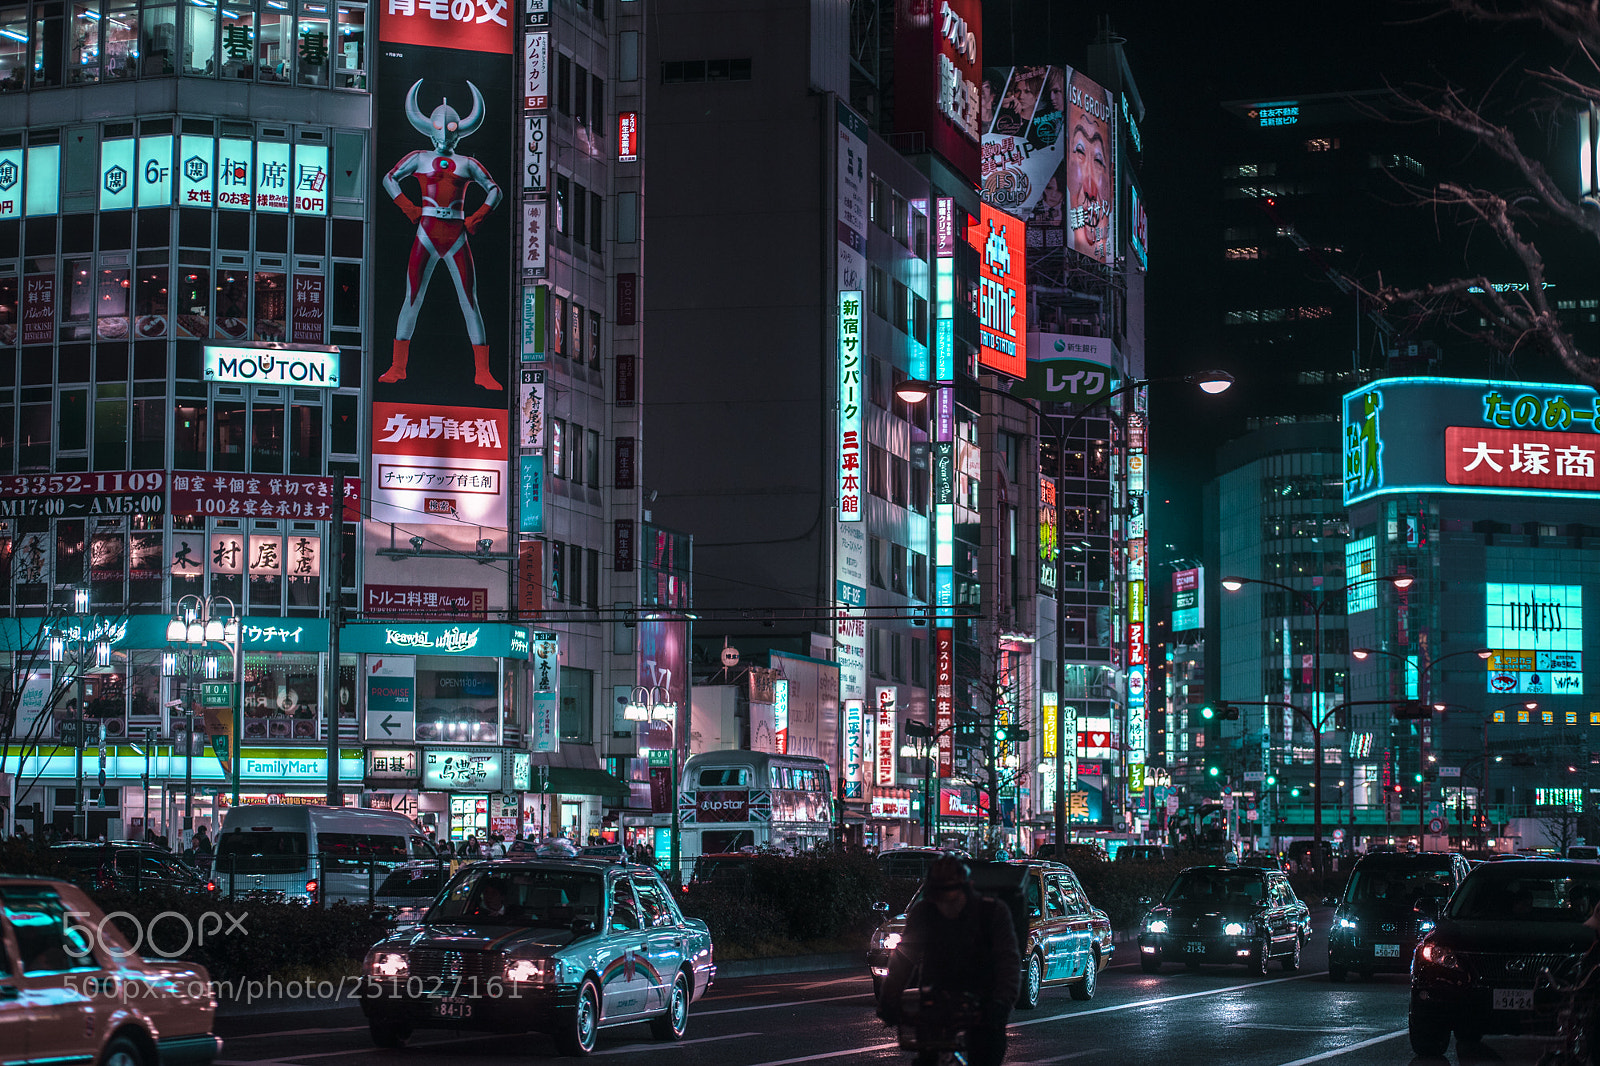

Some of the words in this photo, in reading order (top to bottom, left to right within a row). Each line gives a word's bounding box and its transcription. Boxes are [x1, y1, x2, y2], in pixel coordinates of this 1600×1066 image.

[530, 14, 545, 23] 6F
[528, 36, 542, 92] パムッカレ
[528, 97, 544, 107] 5F
[1069, 83, 1083, 110] ISK
[1084, 94, 1111, 123] GROUP
[528, 118, 544, 186] MOUTON
[145, 159, 169, 184] 6F
[980, 188, 1027, 206] Group
[0, 200, 13, 214] 円
[527, 268, 541, 276] 3F
[28, 280, 53, 291] トルコ
[295, 277, 321, 291] トルコ
[29, 291, 51, 303] 料理
[297, 291, 320, 303] 料理
[25, 322, 53, 333] TURKISH
[295, 322, 322, 331] TURKISH
[525, 293, 535, 345] FamilyMart
[1067, 343, 1097, 354] 新生銀行
[218, 354, 325, 382] MOUTON
[842, 300, 860, 420] 新宿サンパーク
[525, 371, 542, 383] 3F
[1046, 367, 1105, 395] レイク
[1485, 392, 1600, 430] たのめー
[378, 413, 502, 449] ウルトラ育毛剤
[1462, 441, 1596, 478] 大塚商
[384, 471, 492, 489] チャップアップ育毛剤
[841, 431, 860, 513] 三平本館
[172, 475, 206, 493] 個室
[212, 476, 262, 496] 半個室
[269, 478, 359, 501] 貸切できす。
[172, 540, 286, 571] 木村屋
[295, 538, 314, 575] 本店
[369, 589, 438, 608] トルコ料理
[1130, 624, 1142, 664] アイフル
[371, 687, 410, 698] PROMISE
[440, 678, 459, 688] OPEN
[848, 707, 861, 776] 三平ストア
[247, 760, 318, 778] FamilyMart
[373, 756, 406, 773] 囲碁
[1131, 764, 1141, 789] レイク
[393, 793, 418, 815] 4F
[440, 1004, 472, 1017] 84-13
